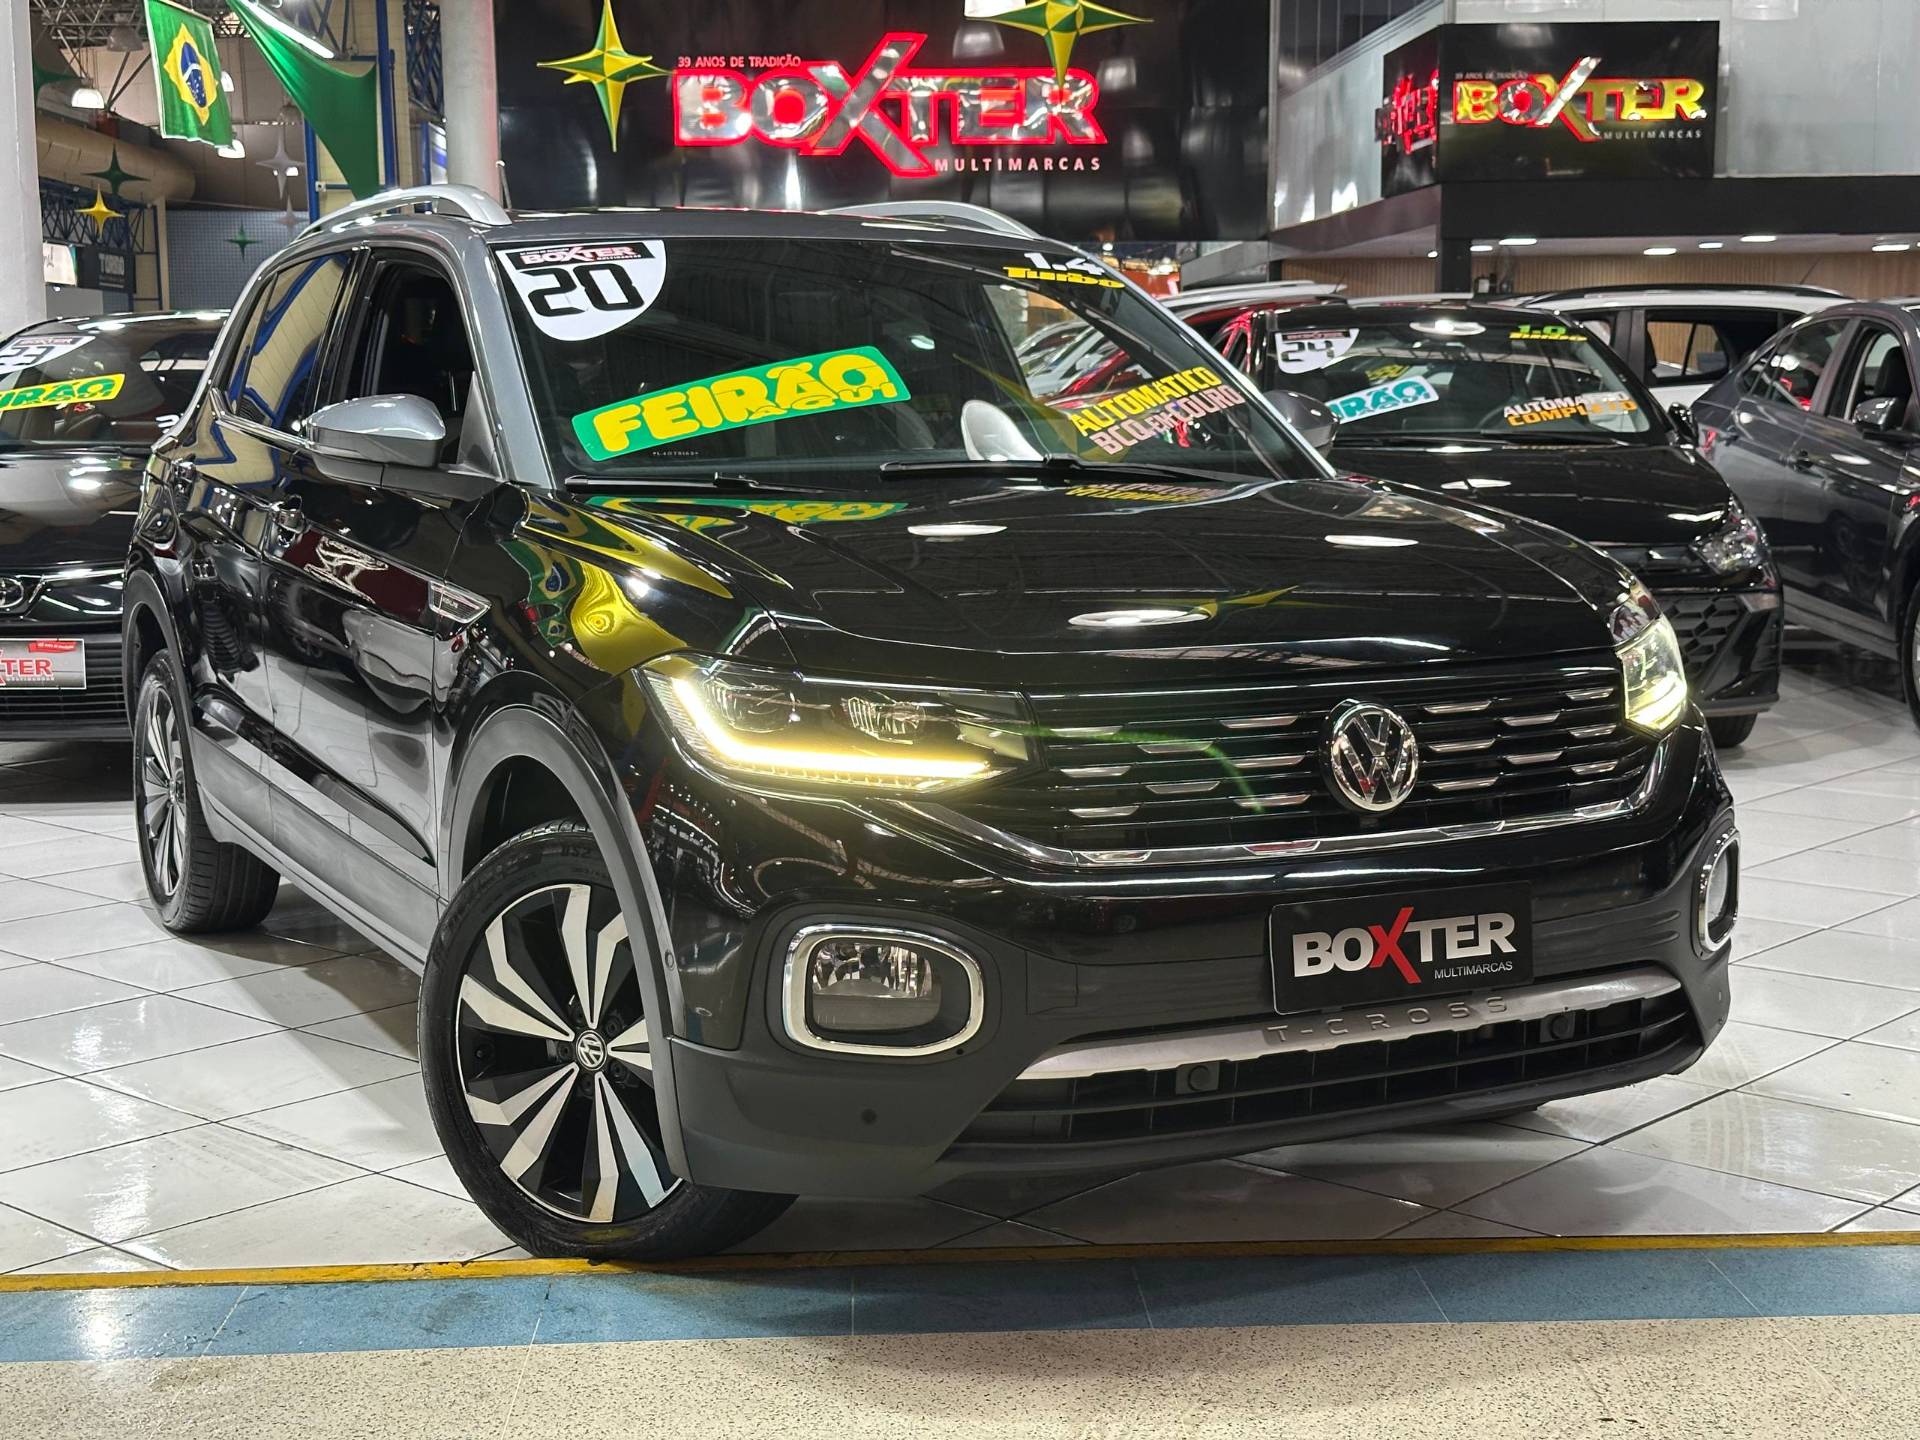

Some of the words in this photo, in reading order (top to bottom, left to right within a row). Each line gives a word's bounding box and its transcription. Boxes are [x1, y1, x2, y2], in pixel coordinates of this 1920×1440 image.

[678, 56, 691, 68] 39
[695, 57, 726, 68] ANOS
[730, 57, 745, 68] DE
[749, 54, 801, 70] TRADIÇÃO
[673, 32, 1108, 178] BOXTER
[1452, 55, 1707, 143] BOXTER
[1603, 129, 1703, 141] MULTIMARCAS
[934, 157, 1101, 173] MULTIMARCAS
[519, 246, 636, 265] BOXTER
[1024, 252, 1105, 275] 1.4
[519, 262, 645, 317] 20
[593, 354, 889, 453] FEIRÃO
[1164, 384, 1246, 422] COURO
[1328, 380, 1427, 414] IRÃO
[1292, 906, 1518, 985] BOXTER
[1434, 961, 1513, 980] MULTIMARCAS
[1267, 996, 1508, 1043] T-CROSS
